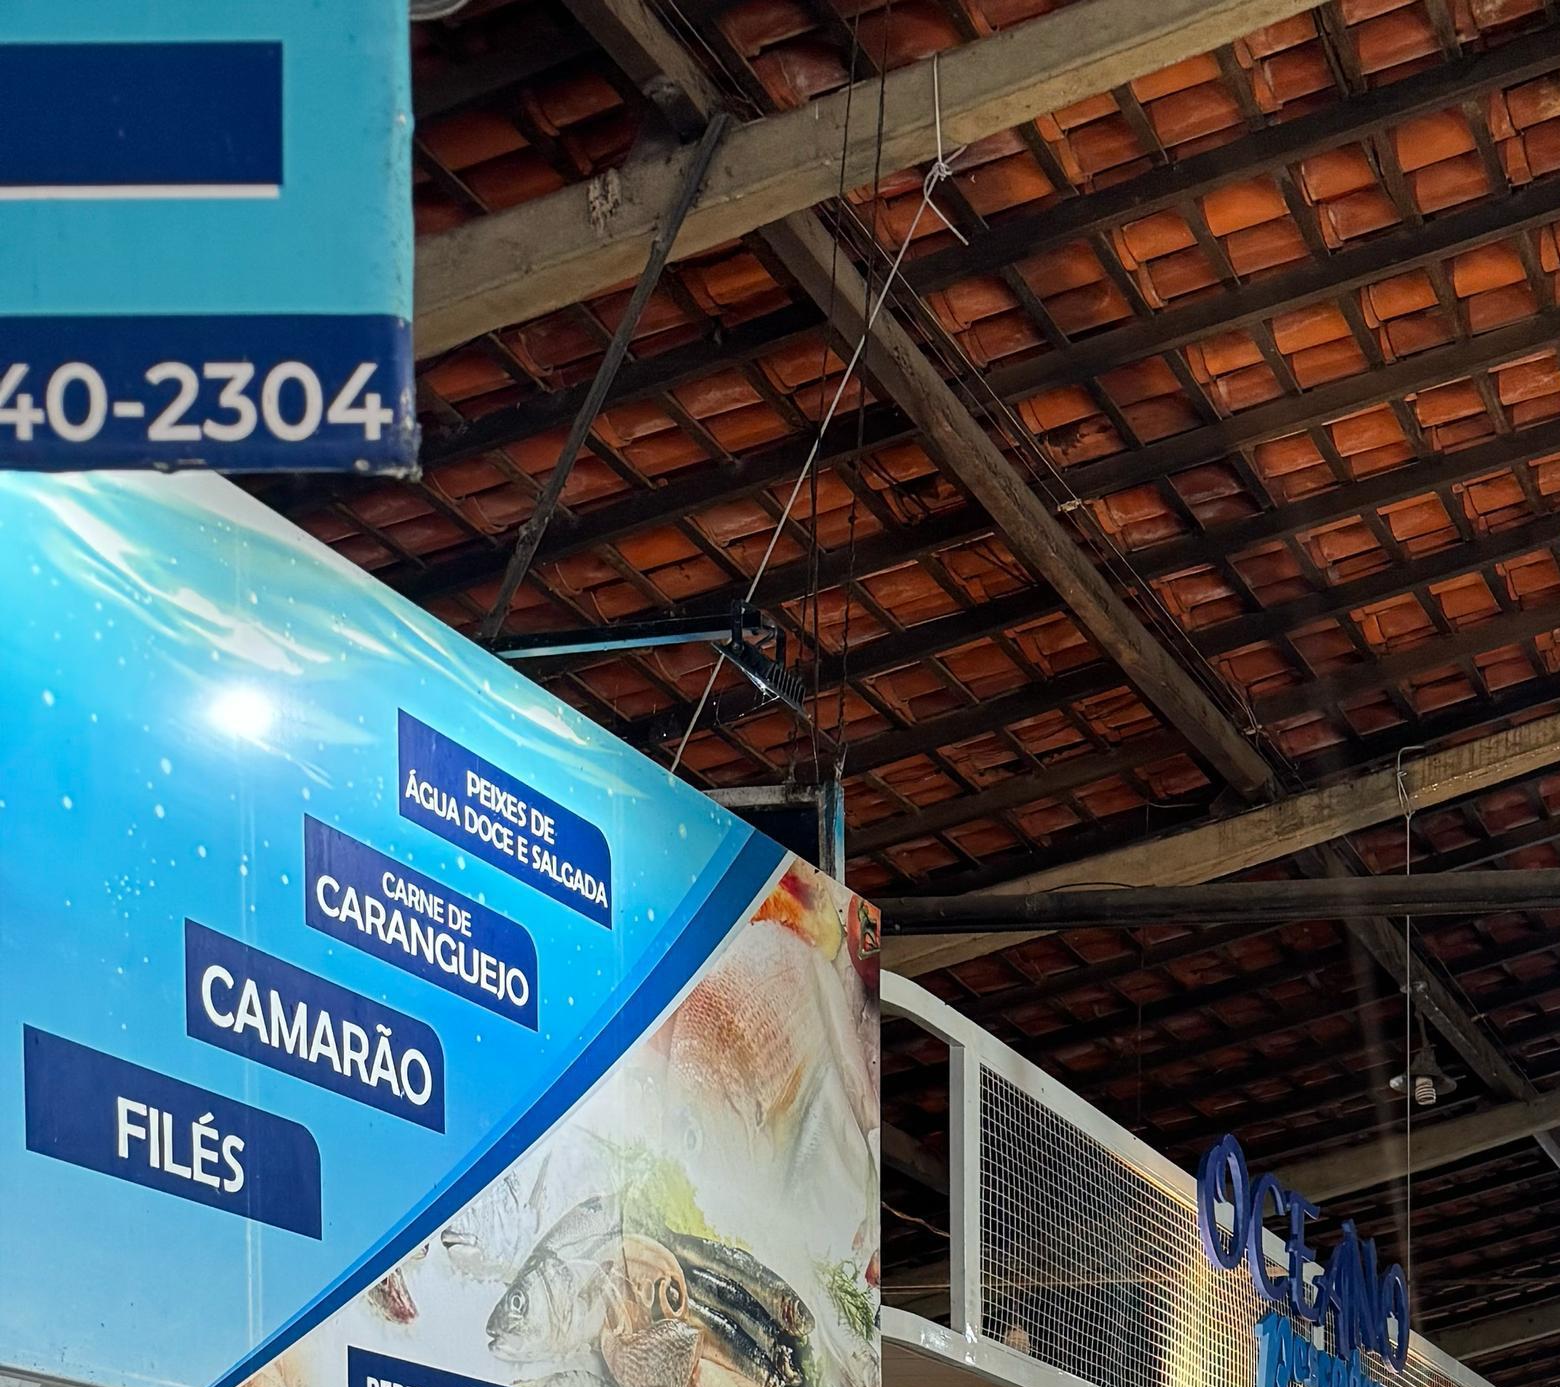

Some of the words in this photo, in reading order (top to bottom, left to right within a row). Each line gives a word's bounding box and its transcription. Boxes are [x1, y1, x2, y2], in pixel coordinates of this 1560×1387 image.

[405, 768, 461, 826] ÁGUA
[464, 805, 514, 857] DOCE
[517, 835, 528, 864] E
[532, 844, 609, 909] SALGADA
[466, 769, 527, 827] PEIXES
[530, 807, 555, 845] DE
[316, 873, 530, 1007] CARANGUEJO
[382, 871, 445, 924] CARNE
[448, 902, 472, 938] DE
[201, 965, 433, 1106] CAMARÃO
[117, 1095, 246, 1193] FILÉS
